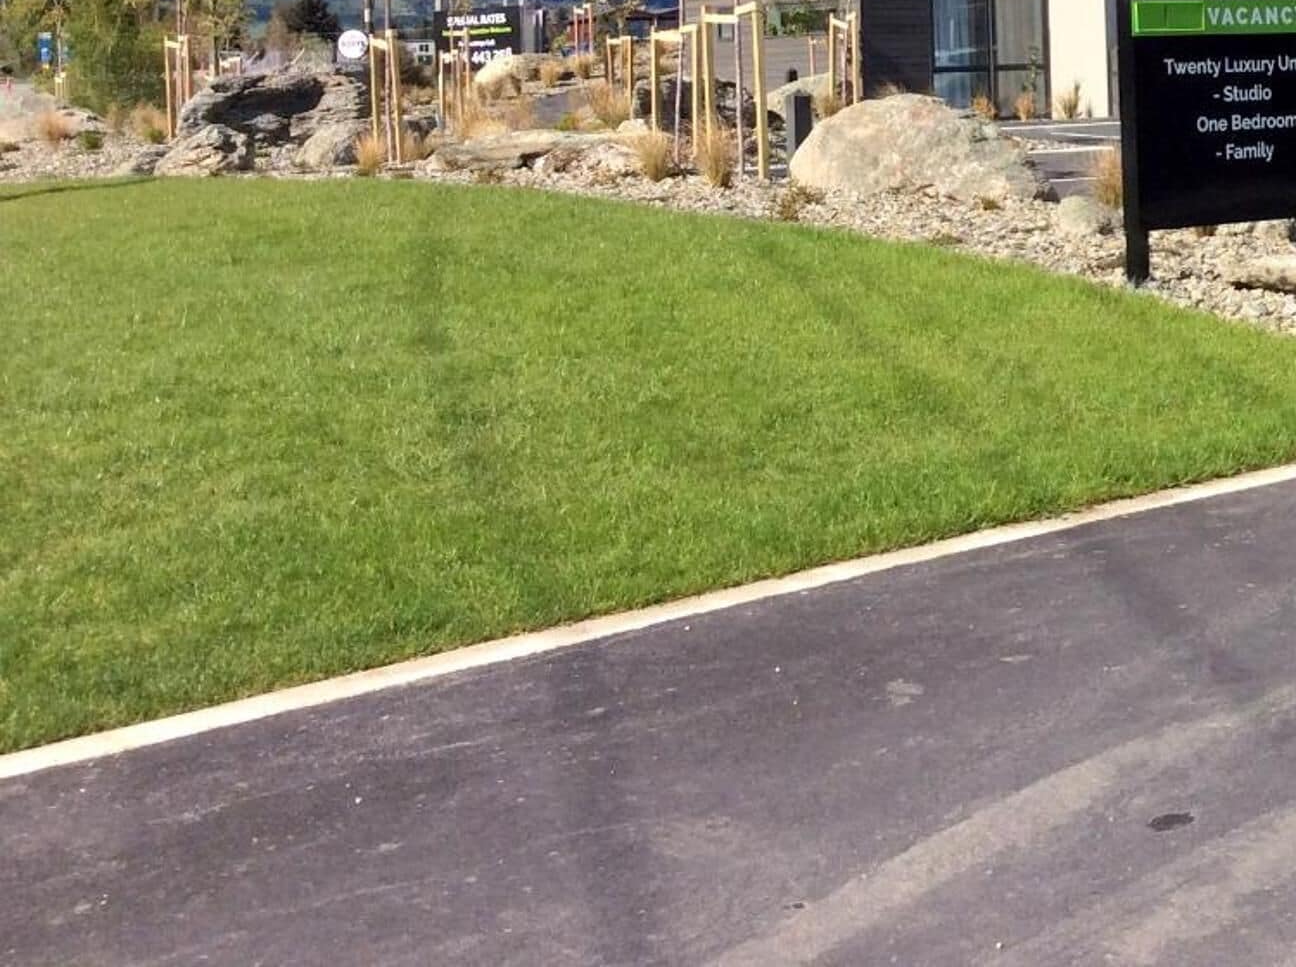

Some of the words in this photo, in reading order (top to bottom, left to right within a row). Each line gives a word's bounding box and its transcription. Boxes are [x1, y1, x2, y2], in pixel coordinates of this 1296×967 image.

[1163, 58, 1221, 78] Twenty
[1224, 56, 1275, 76] Luxury
[1223, 84, 1273, 102] Studio
[1196, 116, 1229, 132] One
[1225, 141, 1275, 162] Family
